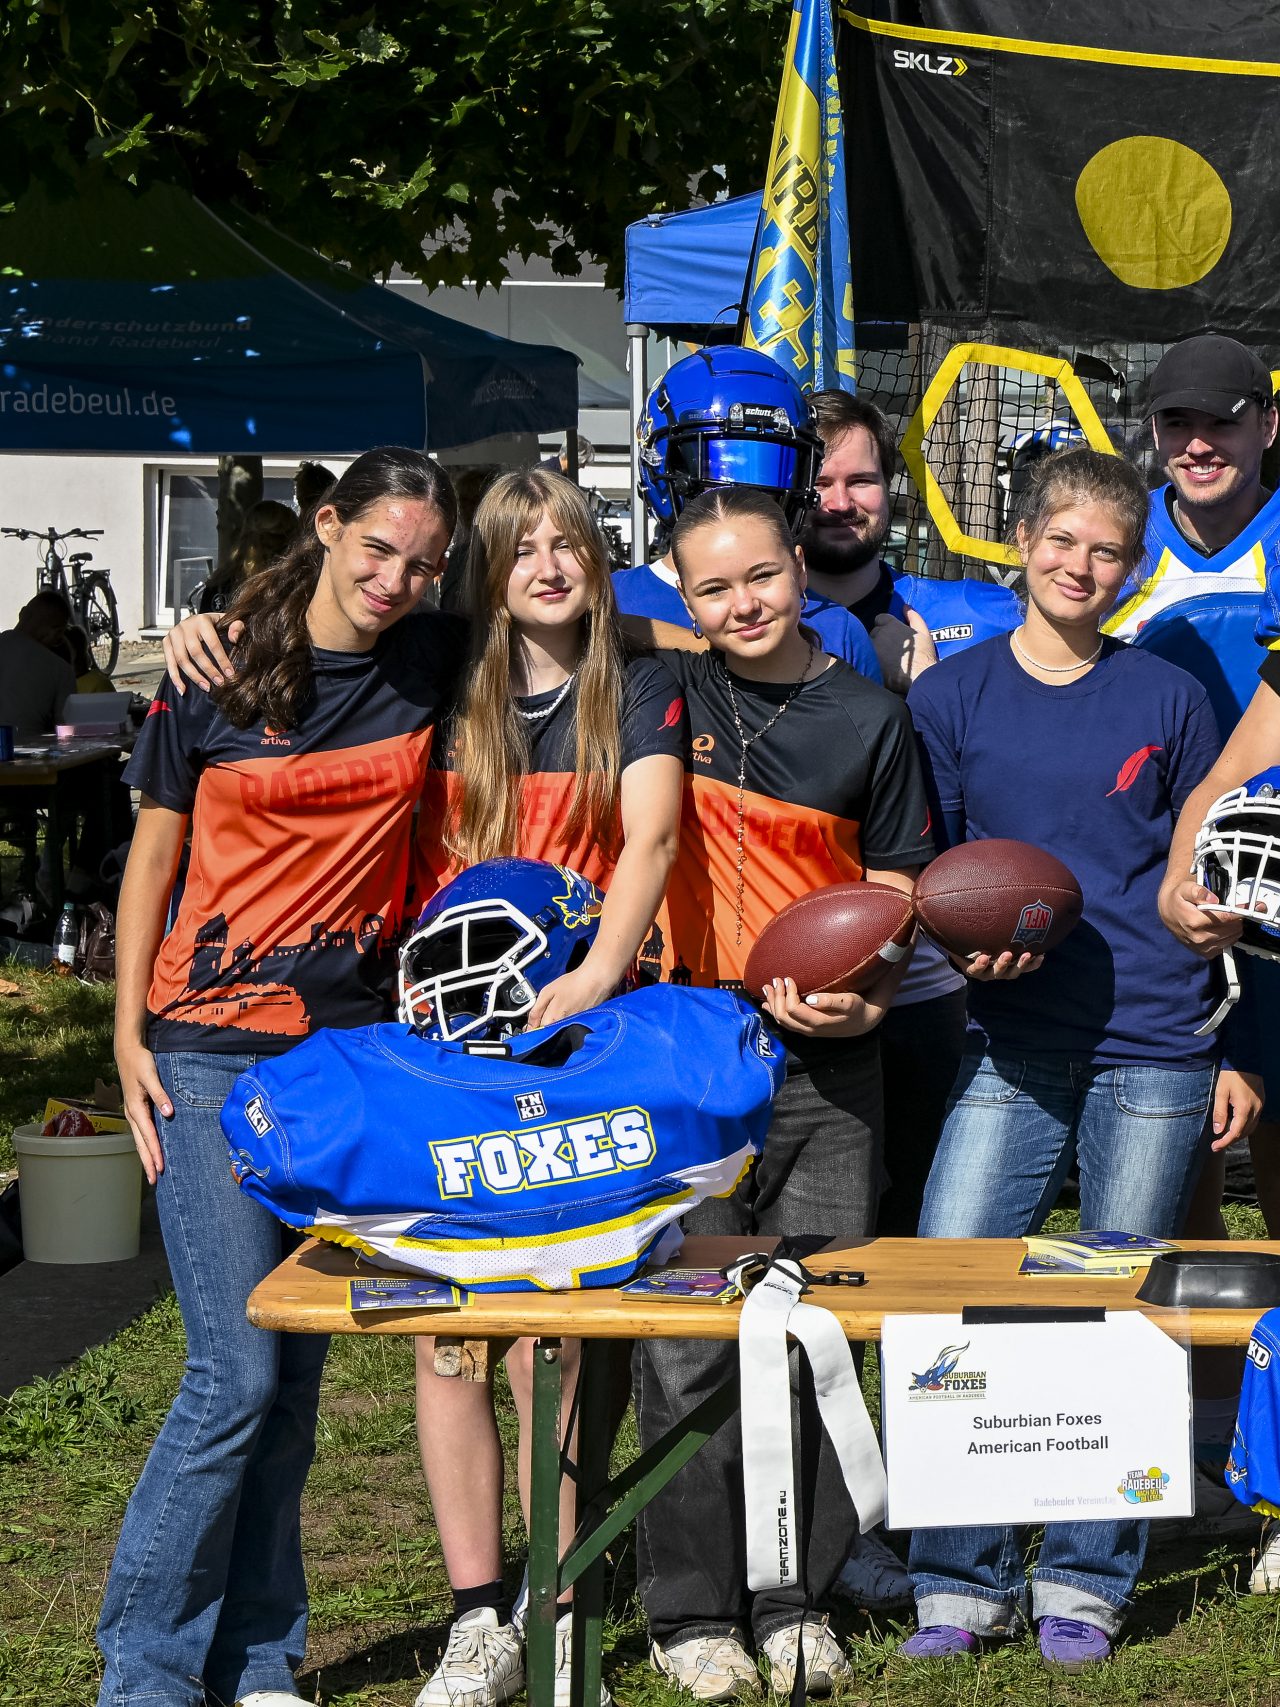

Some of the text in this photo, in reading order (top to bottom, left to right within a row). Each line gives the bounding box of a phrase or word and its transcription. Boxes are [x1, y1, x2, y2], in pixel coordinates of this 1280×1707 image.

[894, 50, 953, 76] SKLZ
[930, 626, 971, 641] TNKD
[260, 736, 291, 747] artiva
[693, 751, 712, 765] tiva
[1025, 909, 1050, 929] NFL
[430, 1105, 656, 1200] FOXES
[944, 1371, 986, 1380] SUBURBIAN
[944, 1379, 987, 1391] FOXES
[973, 1412, 1102, 1429] Suburbian Foxes
[967, 1436, 1109, 1454] American Football
[1128, 1470, 1142, 1479] TEAM
[1122, 1478, 1167, 1491] RADEBEUL
[1034, 1498, 1075, 1507] Radebeuler
